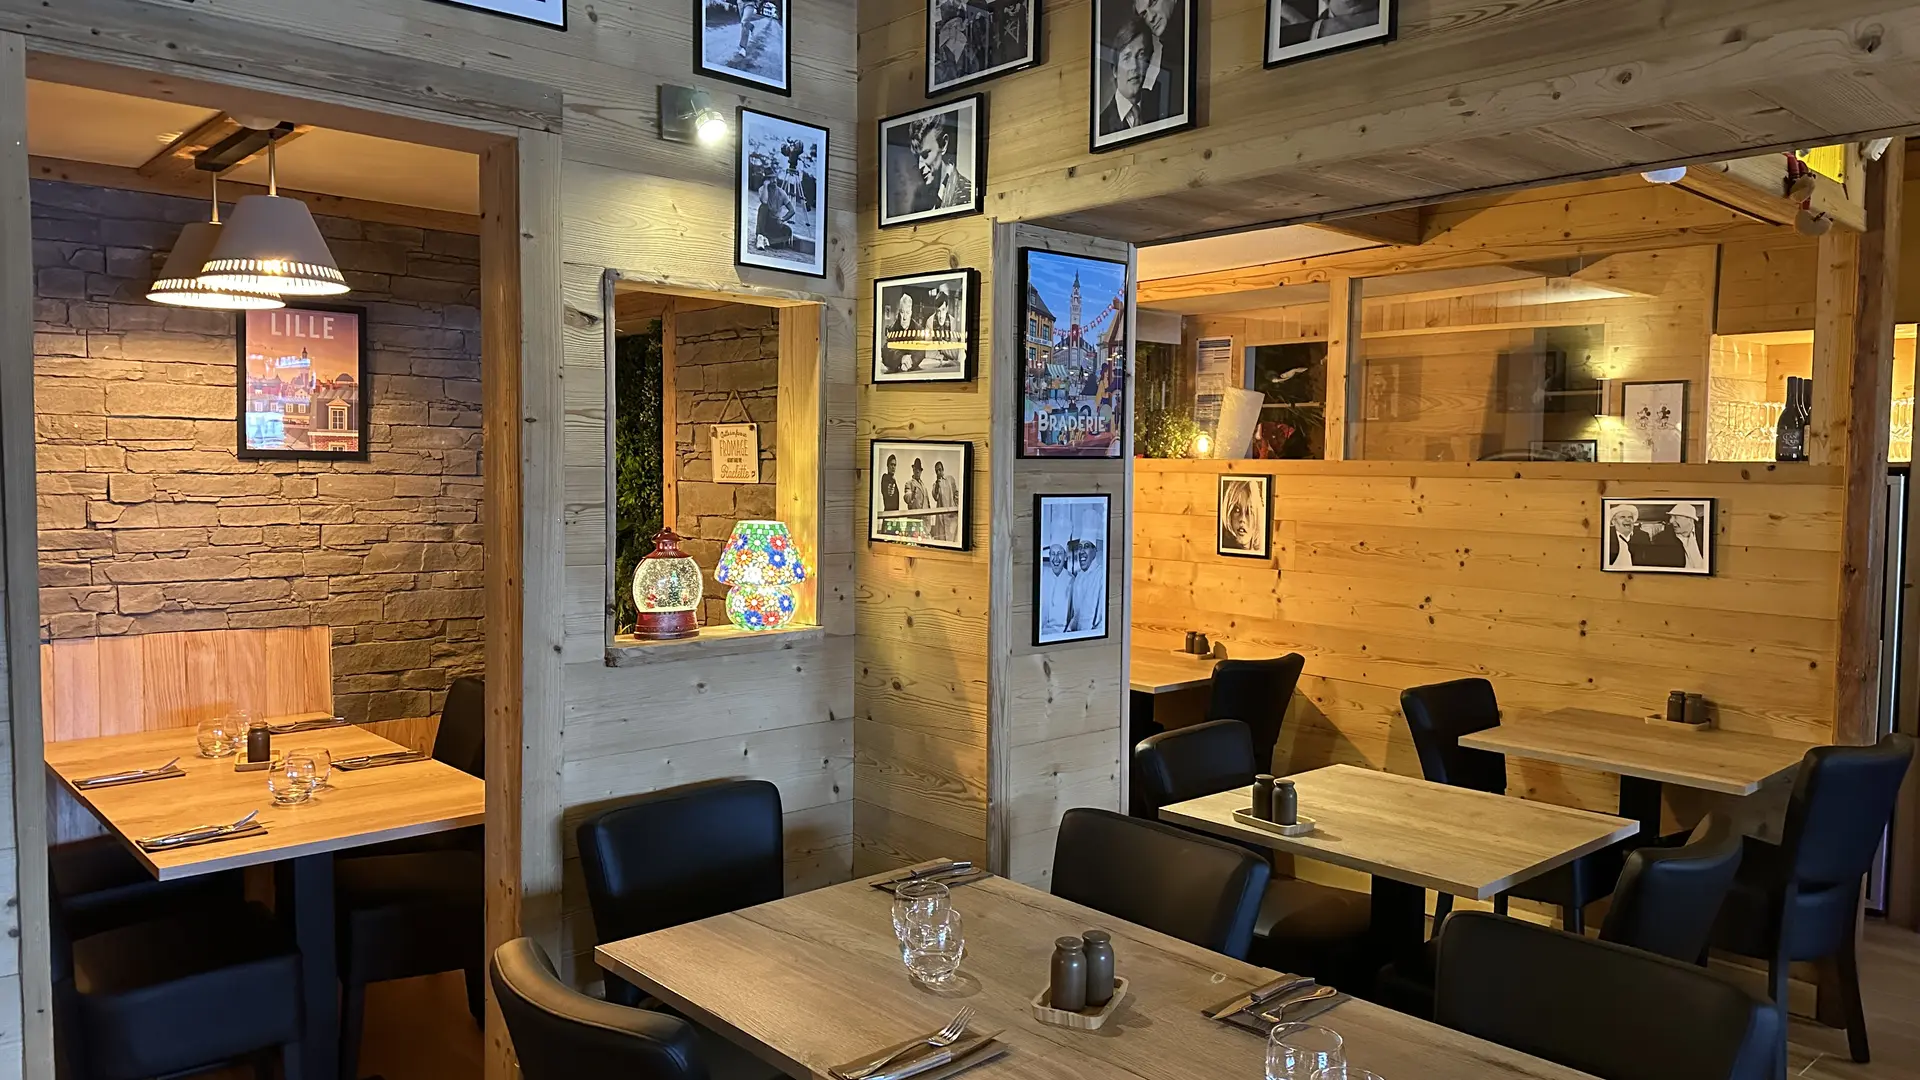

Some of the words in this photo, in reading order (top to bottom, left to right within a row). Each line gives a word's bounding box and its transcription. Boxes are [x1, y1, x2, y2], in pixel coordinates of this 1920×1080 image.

[271, 312, 334, 339] LILLE
[1038, 410, 1106, 434] BRADERIE
[719, 439, 748, 456] FROMAGE
[720, 464, 750, 479] Raclette
